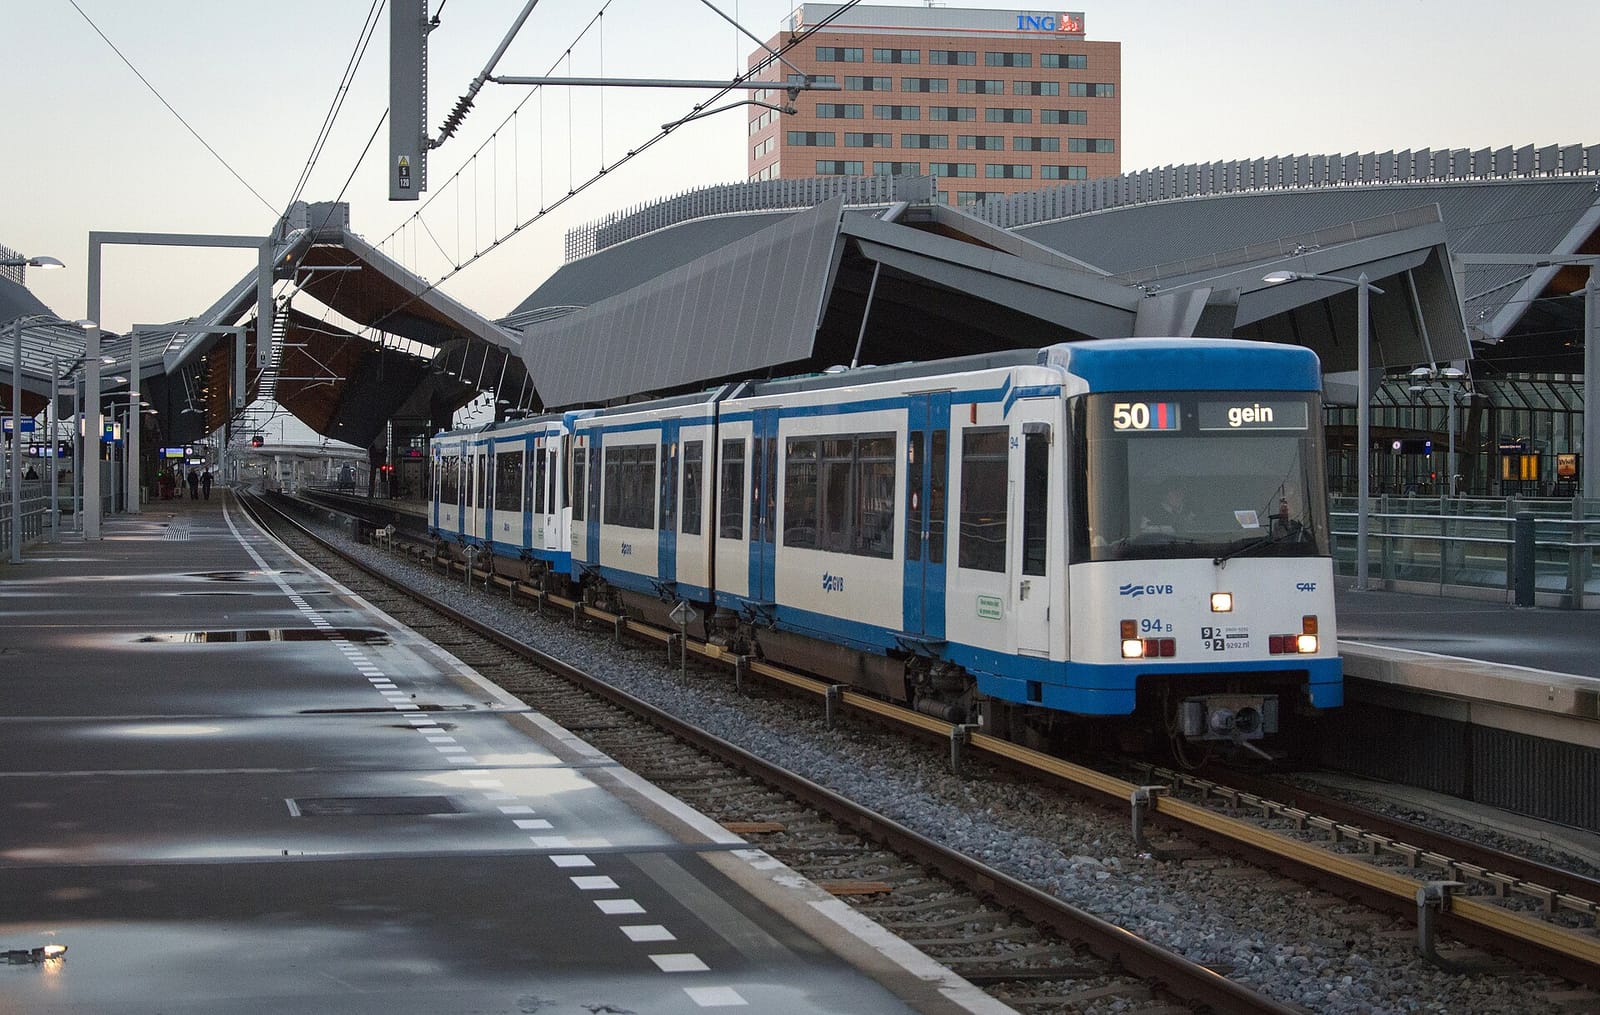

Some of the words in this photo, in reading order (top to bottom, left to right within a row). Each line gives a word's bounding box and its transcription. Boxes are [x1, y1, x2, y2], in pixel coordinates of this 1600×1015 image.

[1017, 15, 1055, 31] ING
[1114, 403, 1150, 429] 50
[1228, 404, 1273, 427] gein
[832, 575, 844, 592] GVB
[1146, 585, 1173, 595] GVB
[1296, 582, 1317, 592] CAF
[1141, 619, 1163, 632] 94
[1166, 623, 1173, 632] B
[1226, 641, 1250, 650] 9292.nl
